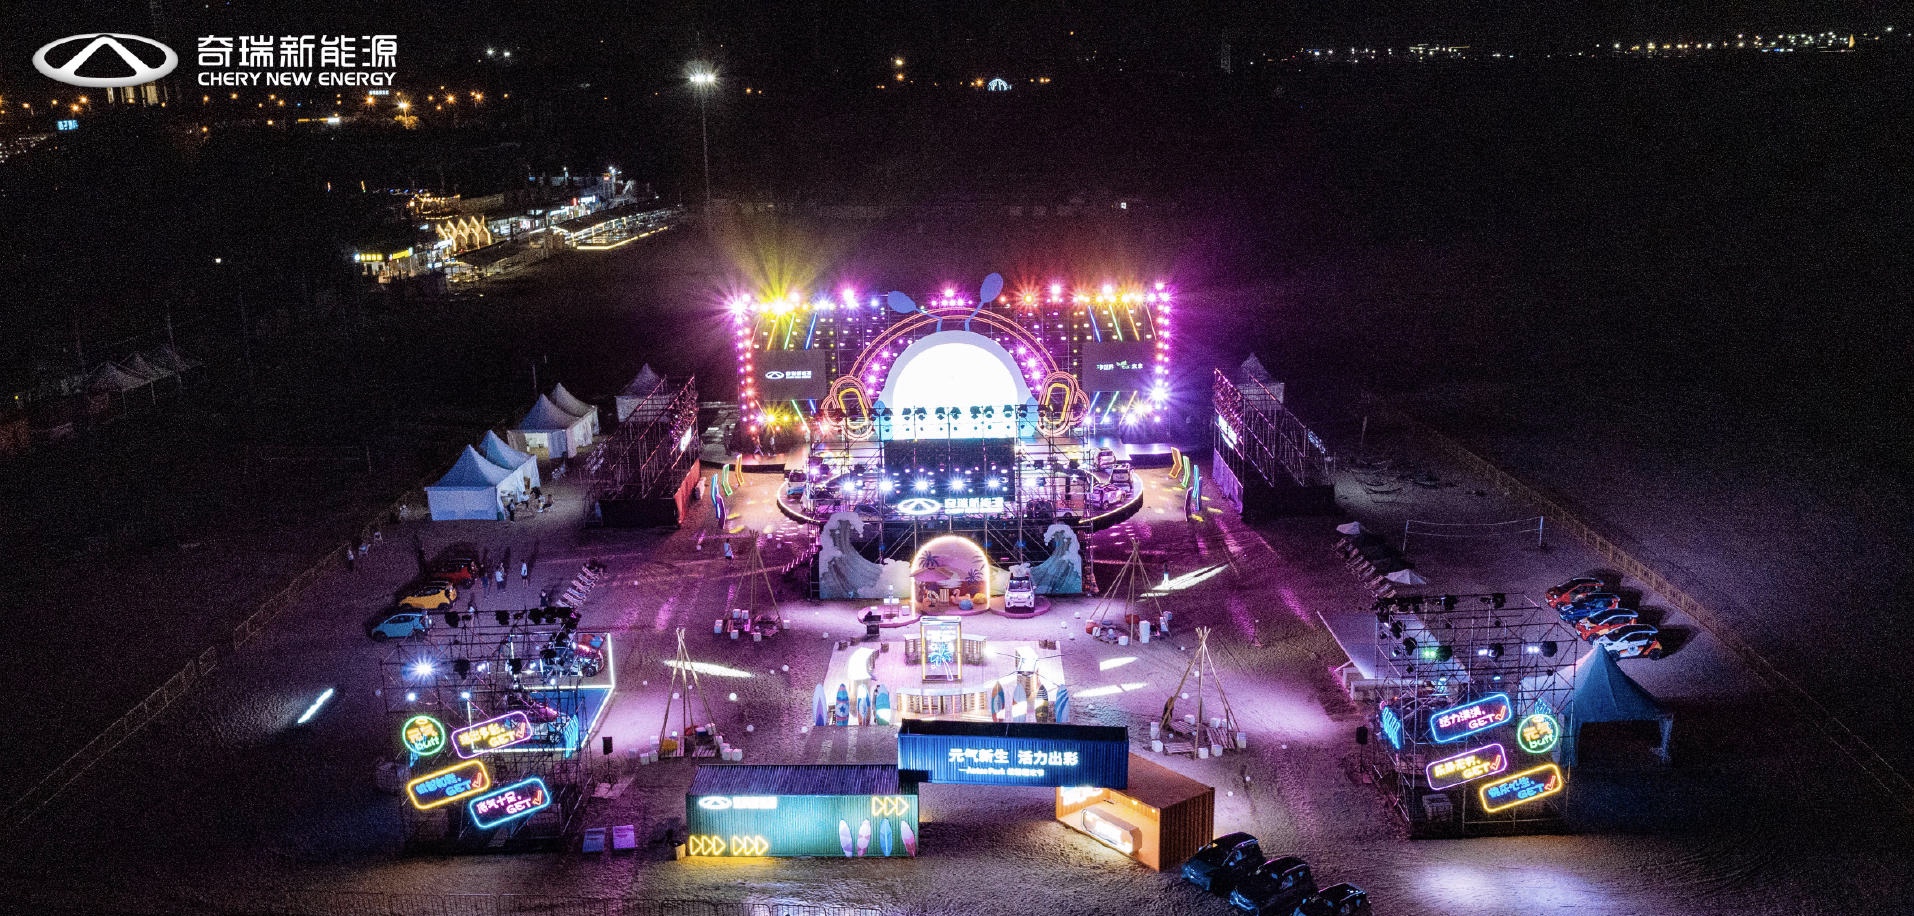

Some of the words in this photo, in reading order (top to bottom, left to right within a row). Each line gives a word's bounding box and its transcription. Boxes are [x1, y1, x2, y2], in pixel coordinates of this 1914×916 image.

[1468, 714, 1495, 729] GET
[488, 731, 515, 747] GET
[949, 748, 1009, 763] 元气新生
[1018, 750, 1078, 766] 活力出彩
[1463, 763, 1490, 779] GET
[445, 779, 471, 796] GET
[1518, 783, 1544, 799] GET
[506, 797, 532, 815] GET
